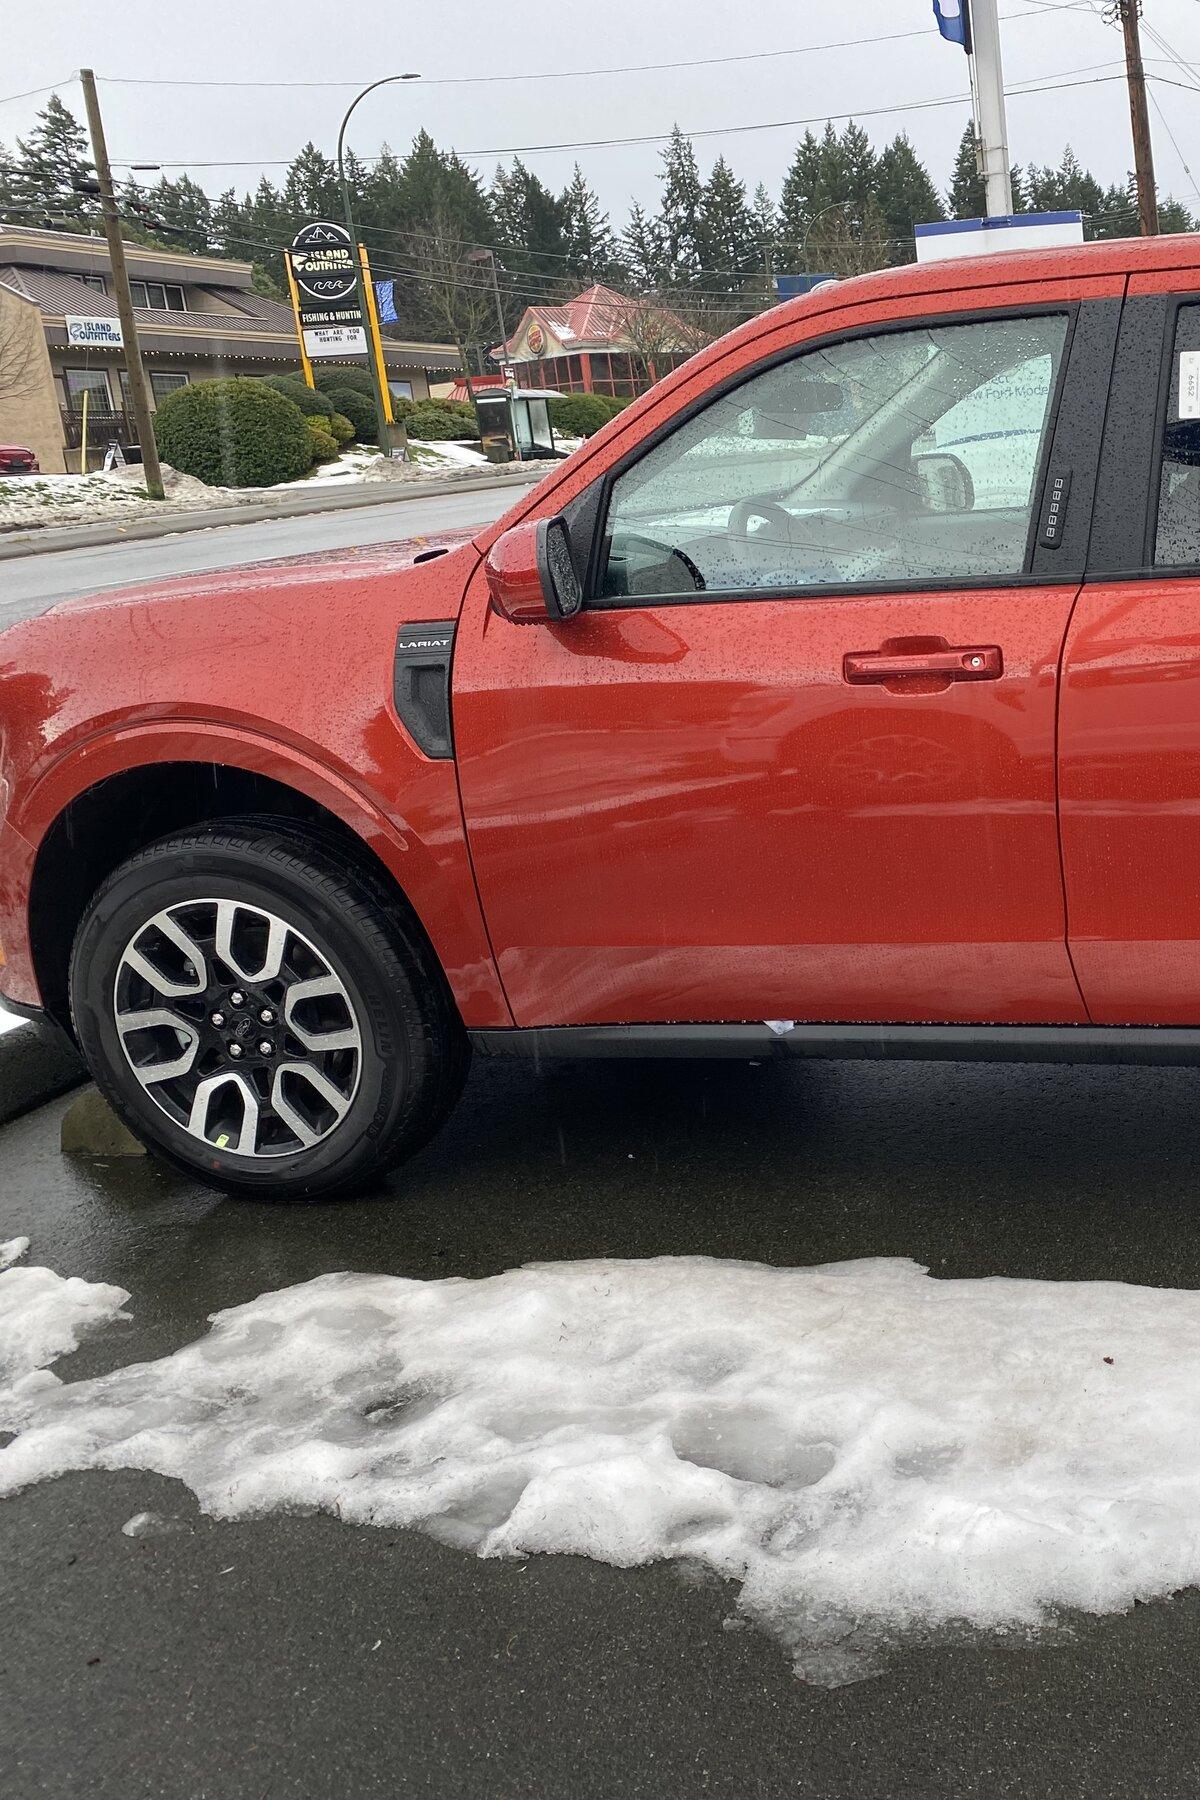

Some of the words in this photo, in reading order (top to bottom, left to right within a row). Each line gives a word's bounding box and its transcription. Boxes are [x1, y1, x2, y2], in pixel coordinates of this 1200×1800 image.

[310, 249, 349, 261] ISLAND
[305, 259, 354, 271] OUTFITTER
[302, 312, 329, 323] FISHING
[329, 312, 336, 320] &
[336, 310, 361, 320] HUNTIN
[84, 322, 112, 332] ISLAND
[80, 331, 121, 341] OUTFITTERS
[314, 329, 329, 337] WHAT
[1015, 385, 1049, 397] Mode
[399, 639, 450, 649] LARIAT
